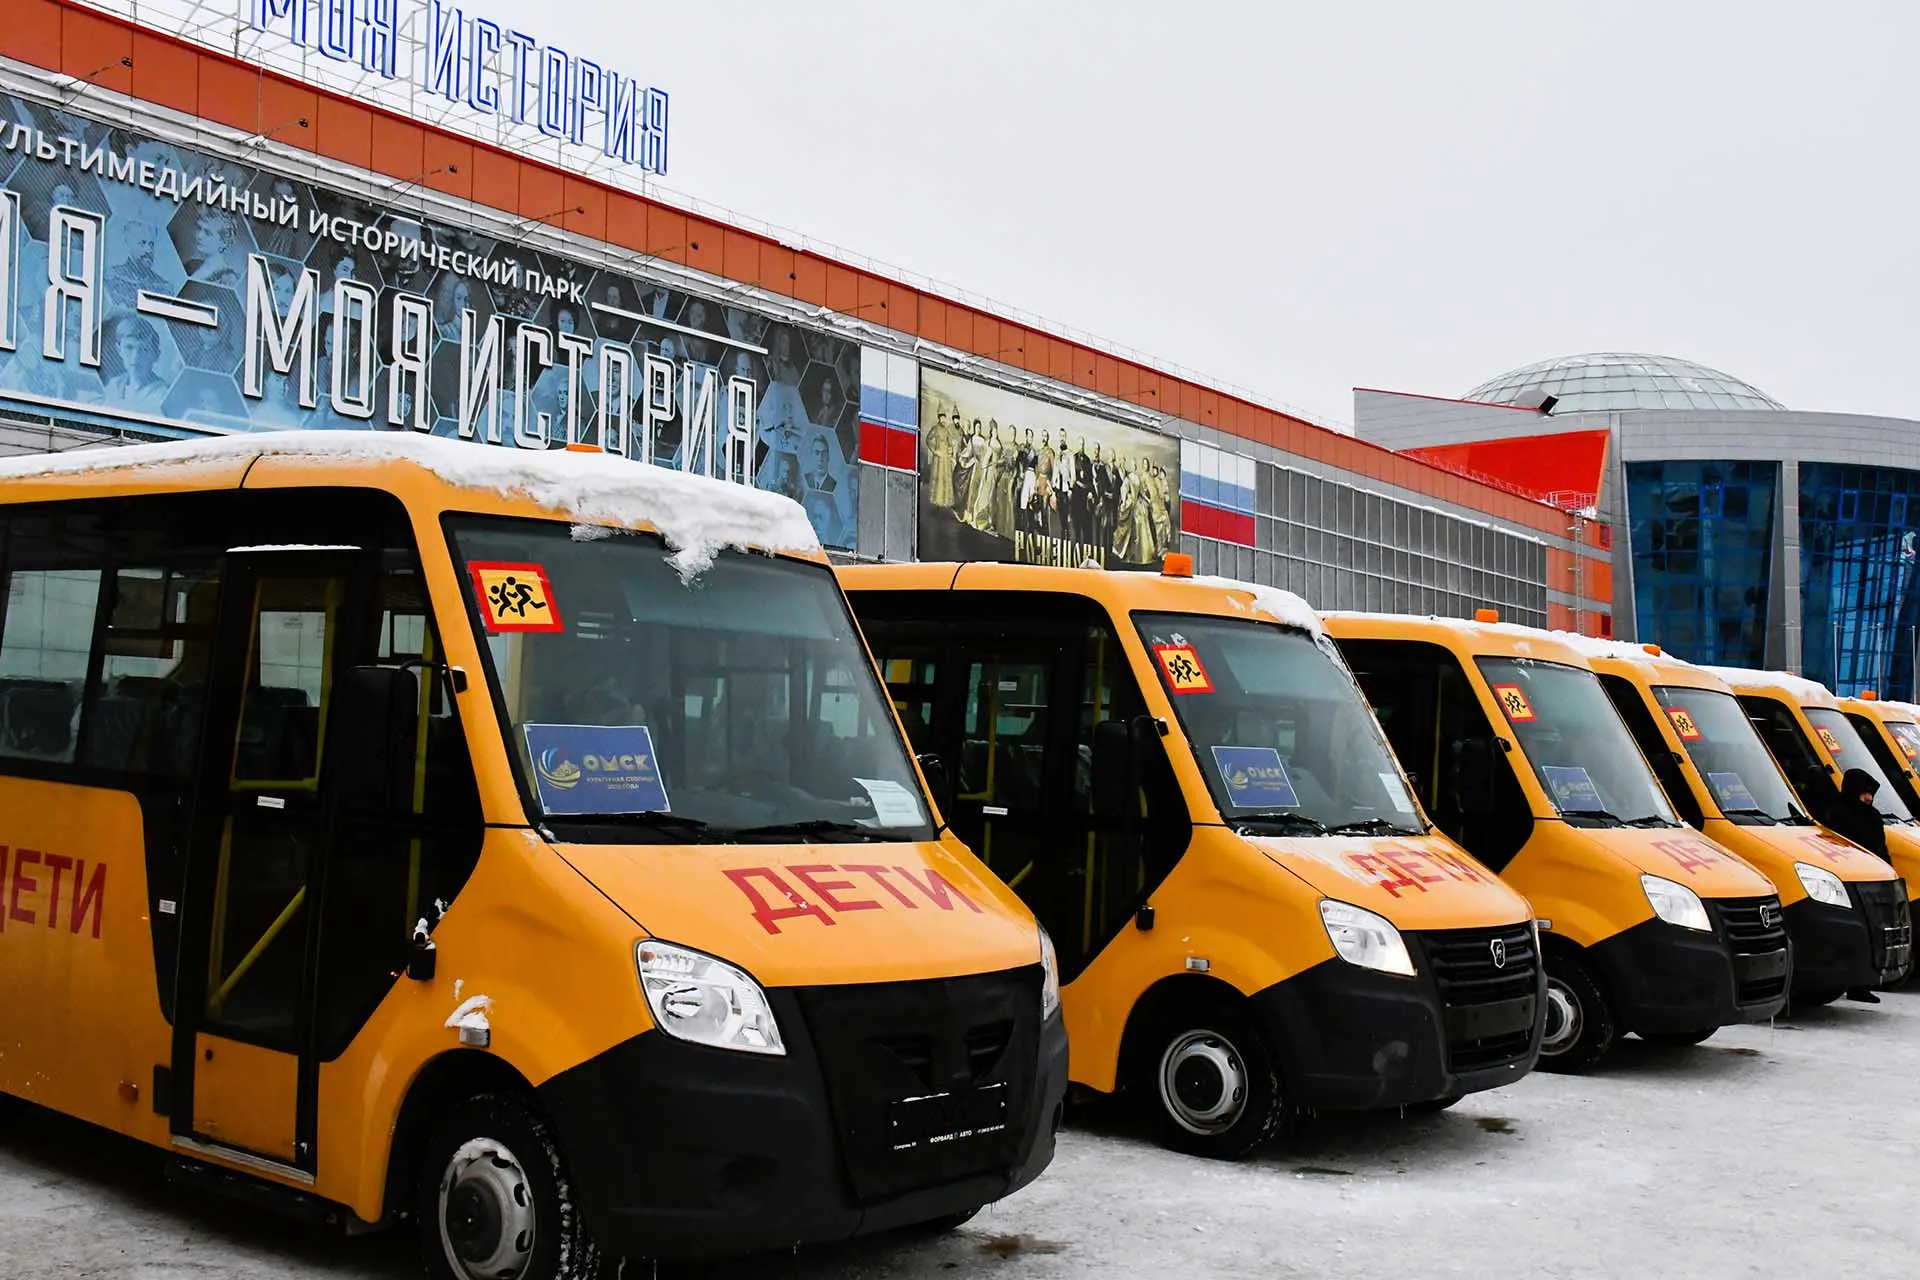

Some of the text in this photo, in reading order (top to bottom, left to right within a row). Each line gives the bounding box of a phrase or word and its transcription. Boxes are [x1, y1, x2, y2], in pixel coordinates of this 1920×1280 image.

[424, 0, 669, 176] ИСТОРИЯ
[0, 119, 584, 305] ЛЬТИМЕДИЙНЫЙ ИСТОРИЧЕСКИЙ ПАРК
[244, 252, 433, 431] МОЯ
[458, 308, 757, 487] ИСТОРИЯ
[583, 754, 652, 771] ОМСК
[0, 845, 107, 940] ЕТИ
[721, 864, 984, 935] ДЕТИ
[1348, 850, 1494, 898] ДЕТИ
